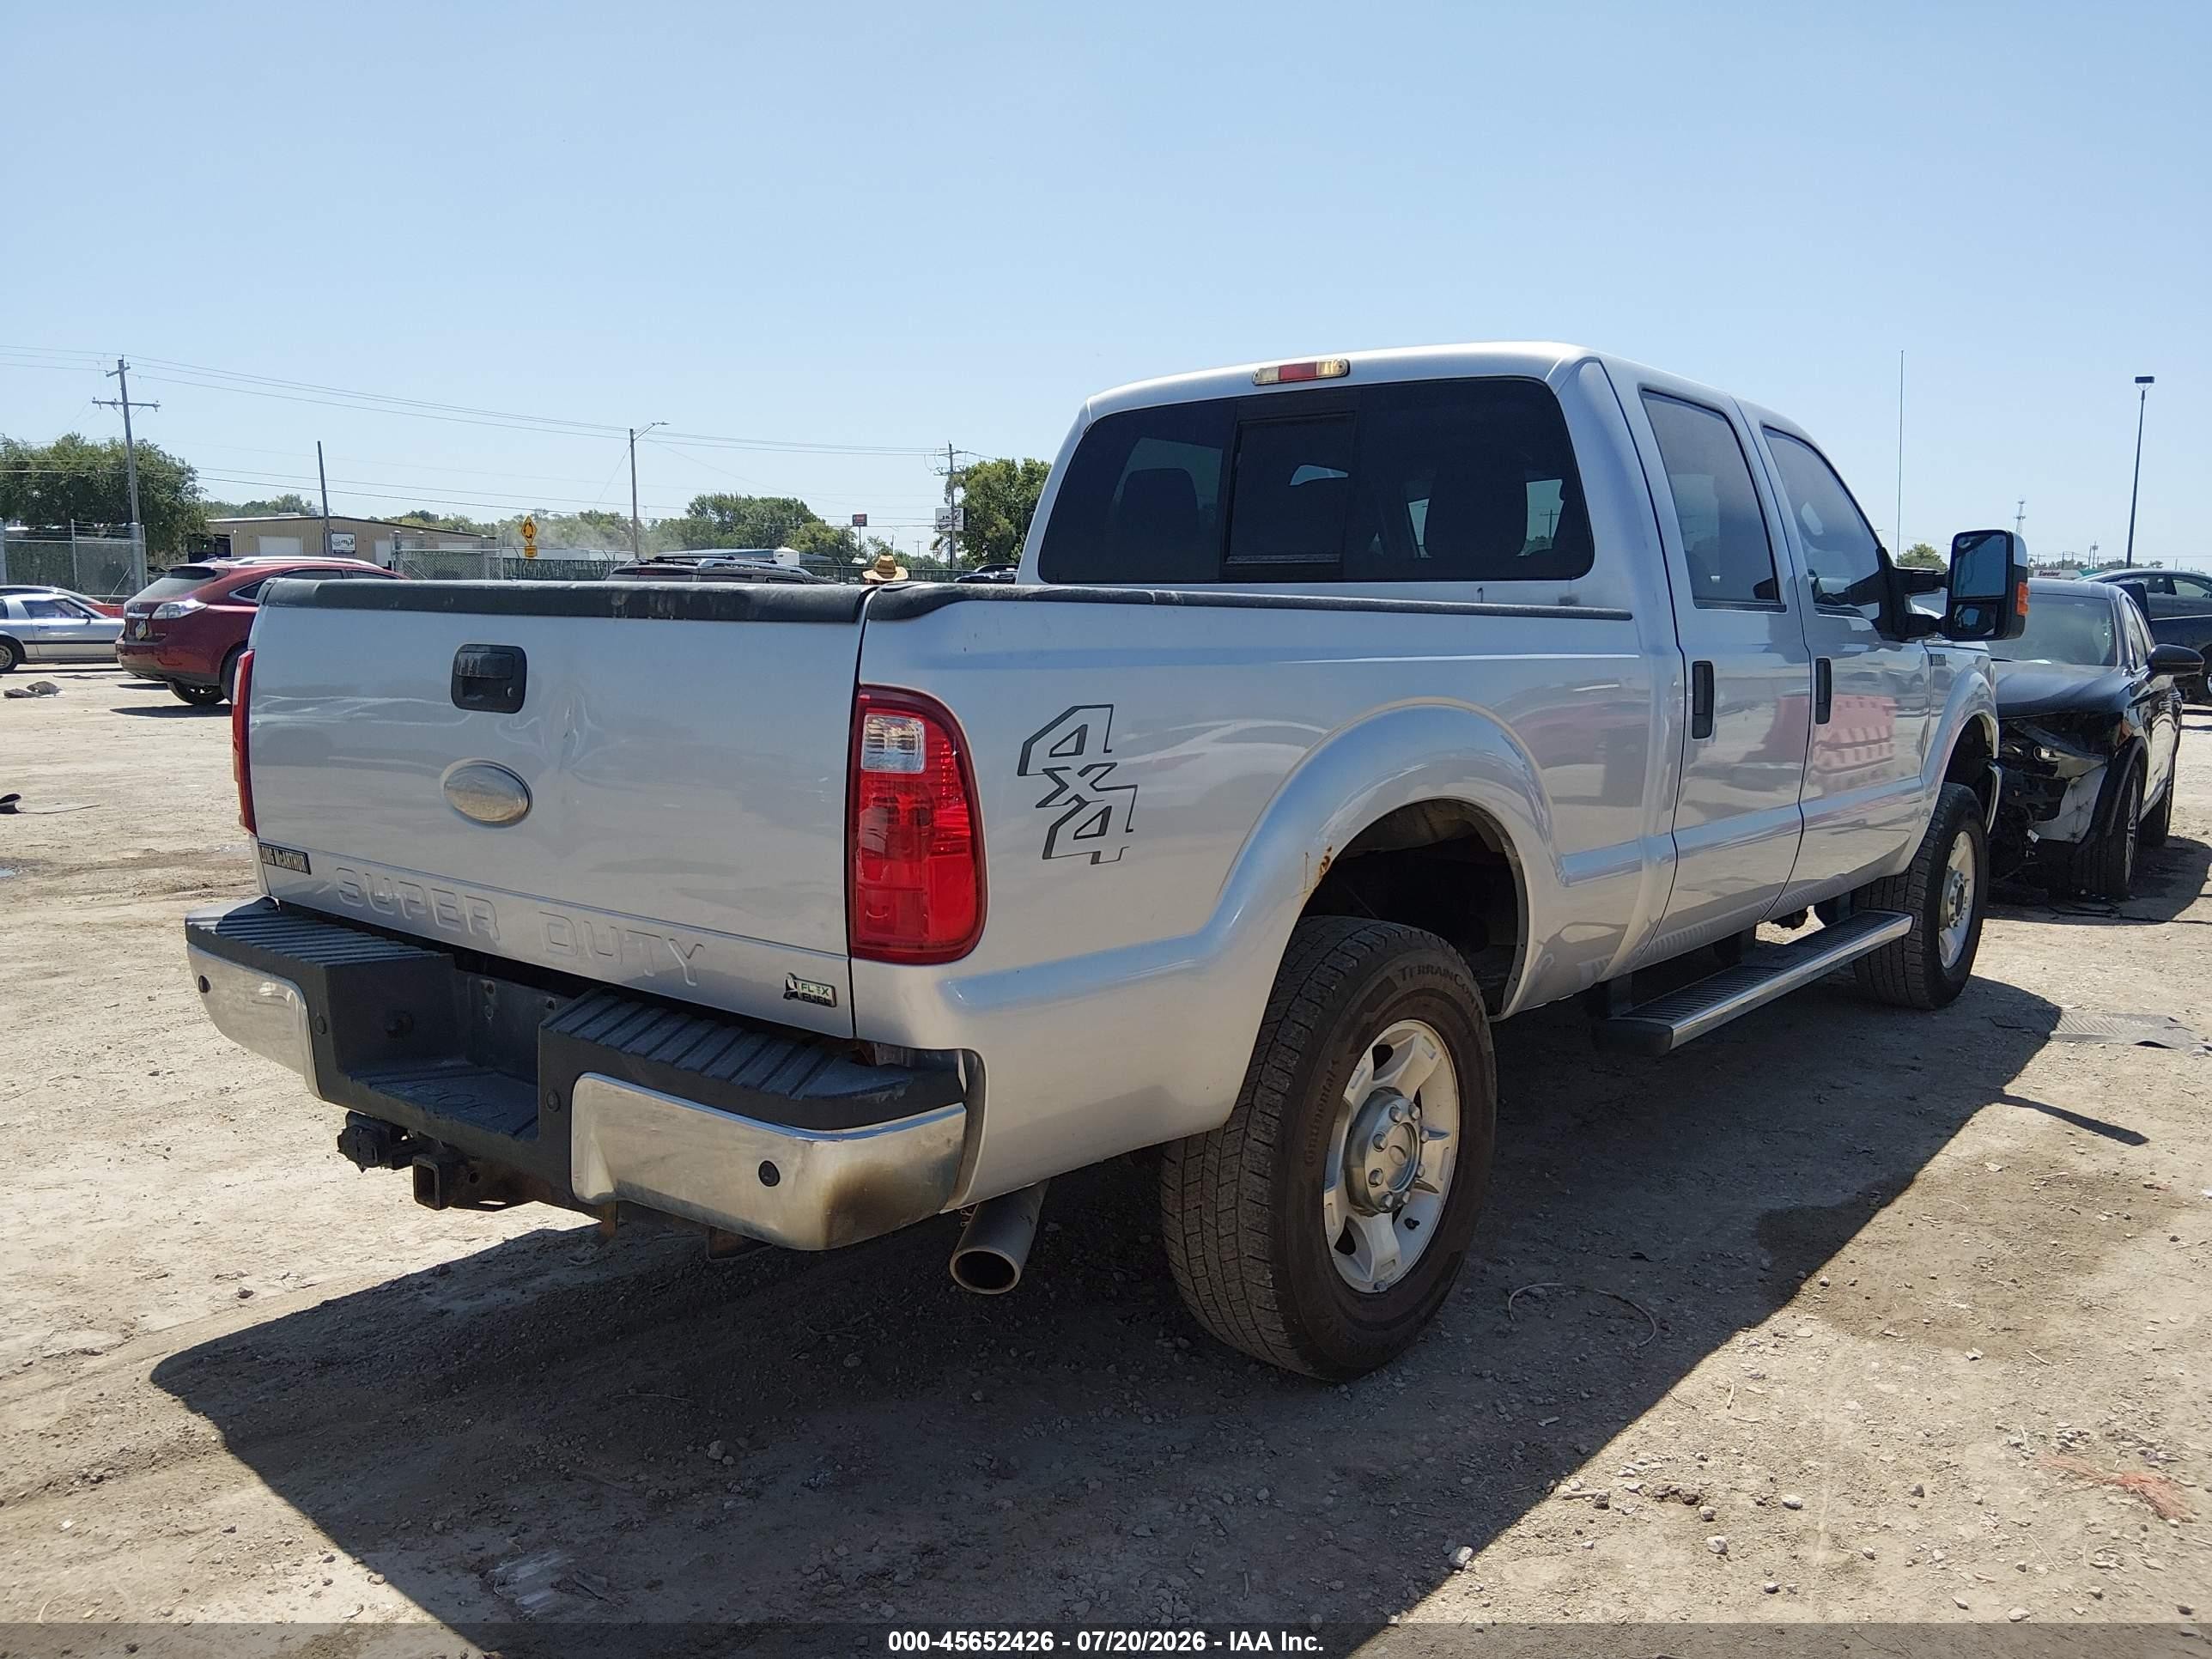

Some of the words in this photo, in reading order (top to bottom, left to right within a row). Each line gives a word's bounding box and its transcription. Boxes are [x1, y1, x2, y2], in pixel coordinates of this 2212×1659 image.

[336, 866, 501, 943] SUPER
[538, 910, 707, 988] DUTY
[800, 982, 830, 997] FLEX
